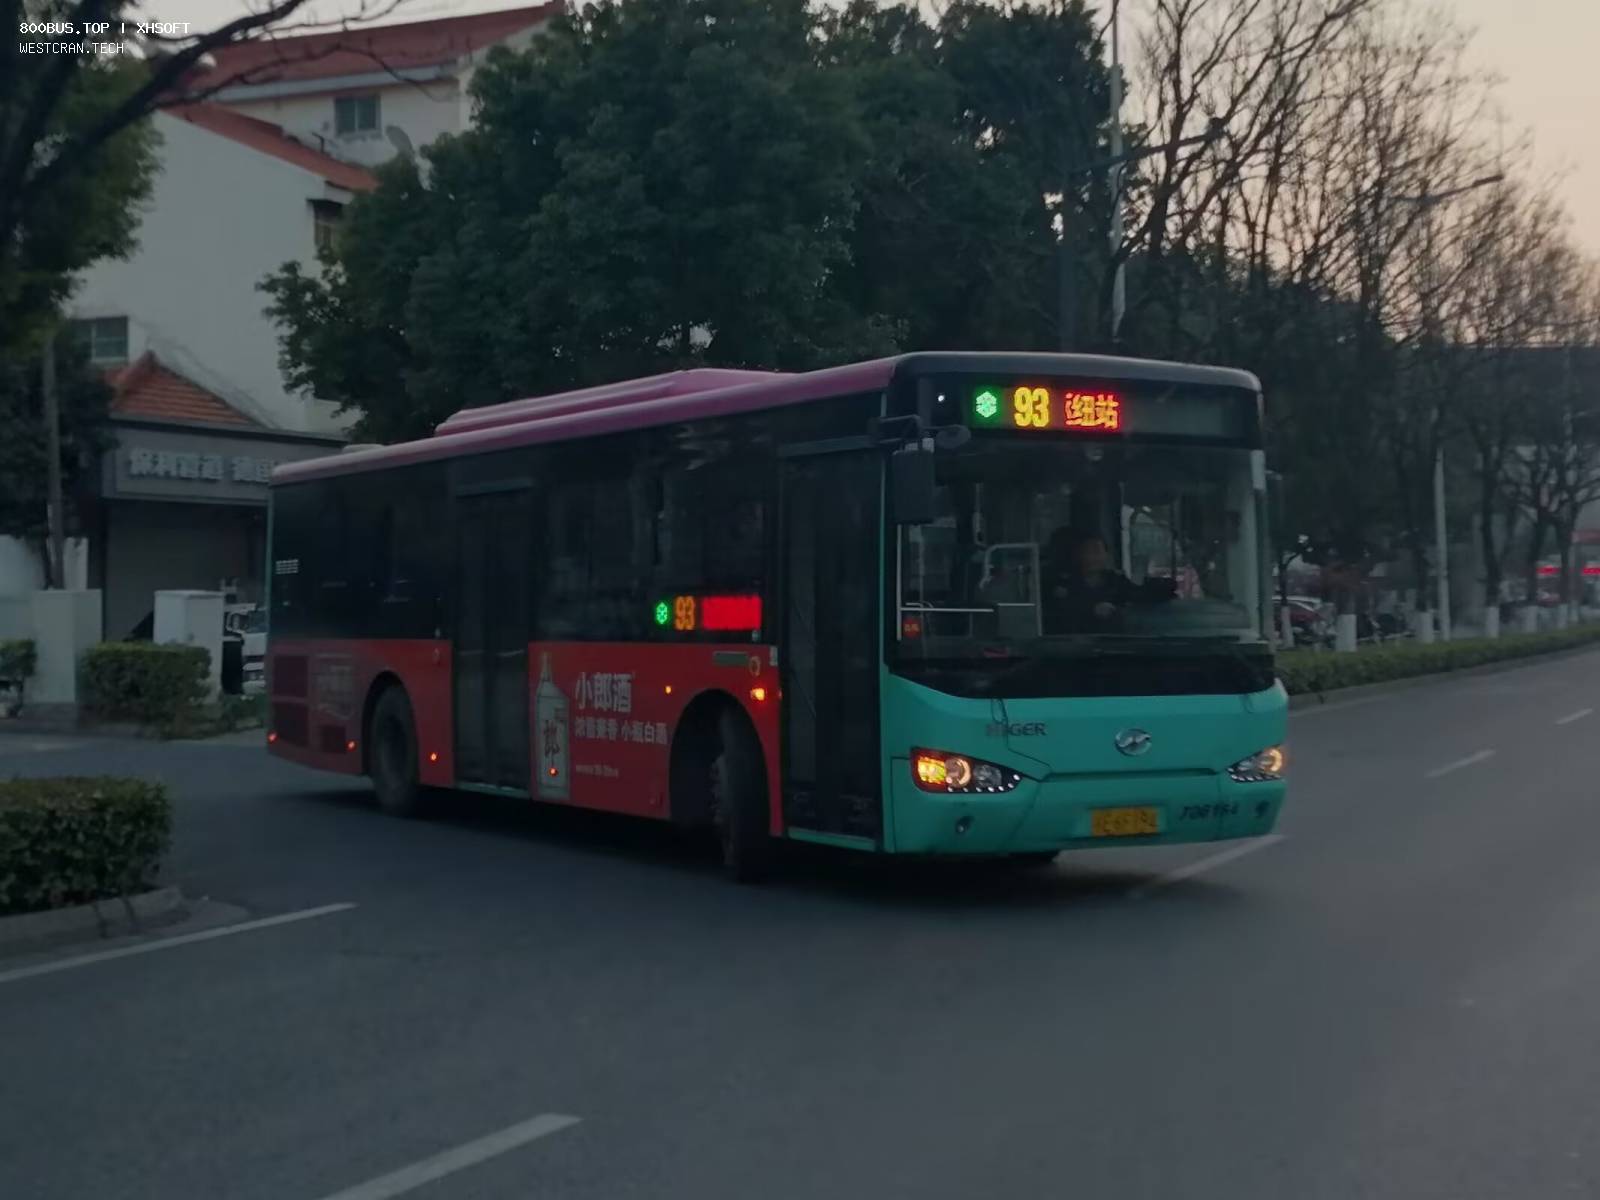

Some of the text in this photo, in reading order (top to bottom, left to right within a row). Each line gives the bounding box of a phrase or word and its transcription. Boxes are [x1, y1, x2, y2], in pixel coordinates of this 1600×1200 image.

[1013, 386, 1050, 428] 93
[674, 595, 696, 631] 93
[575, 671, 632, 713] 小郎酒
